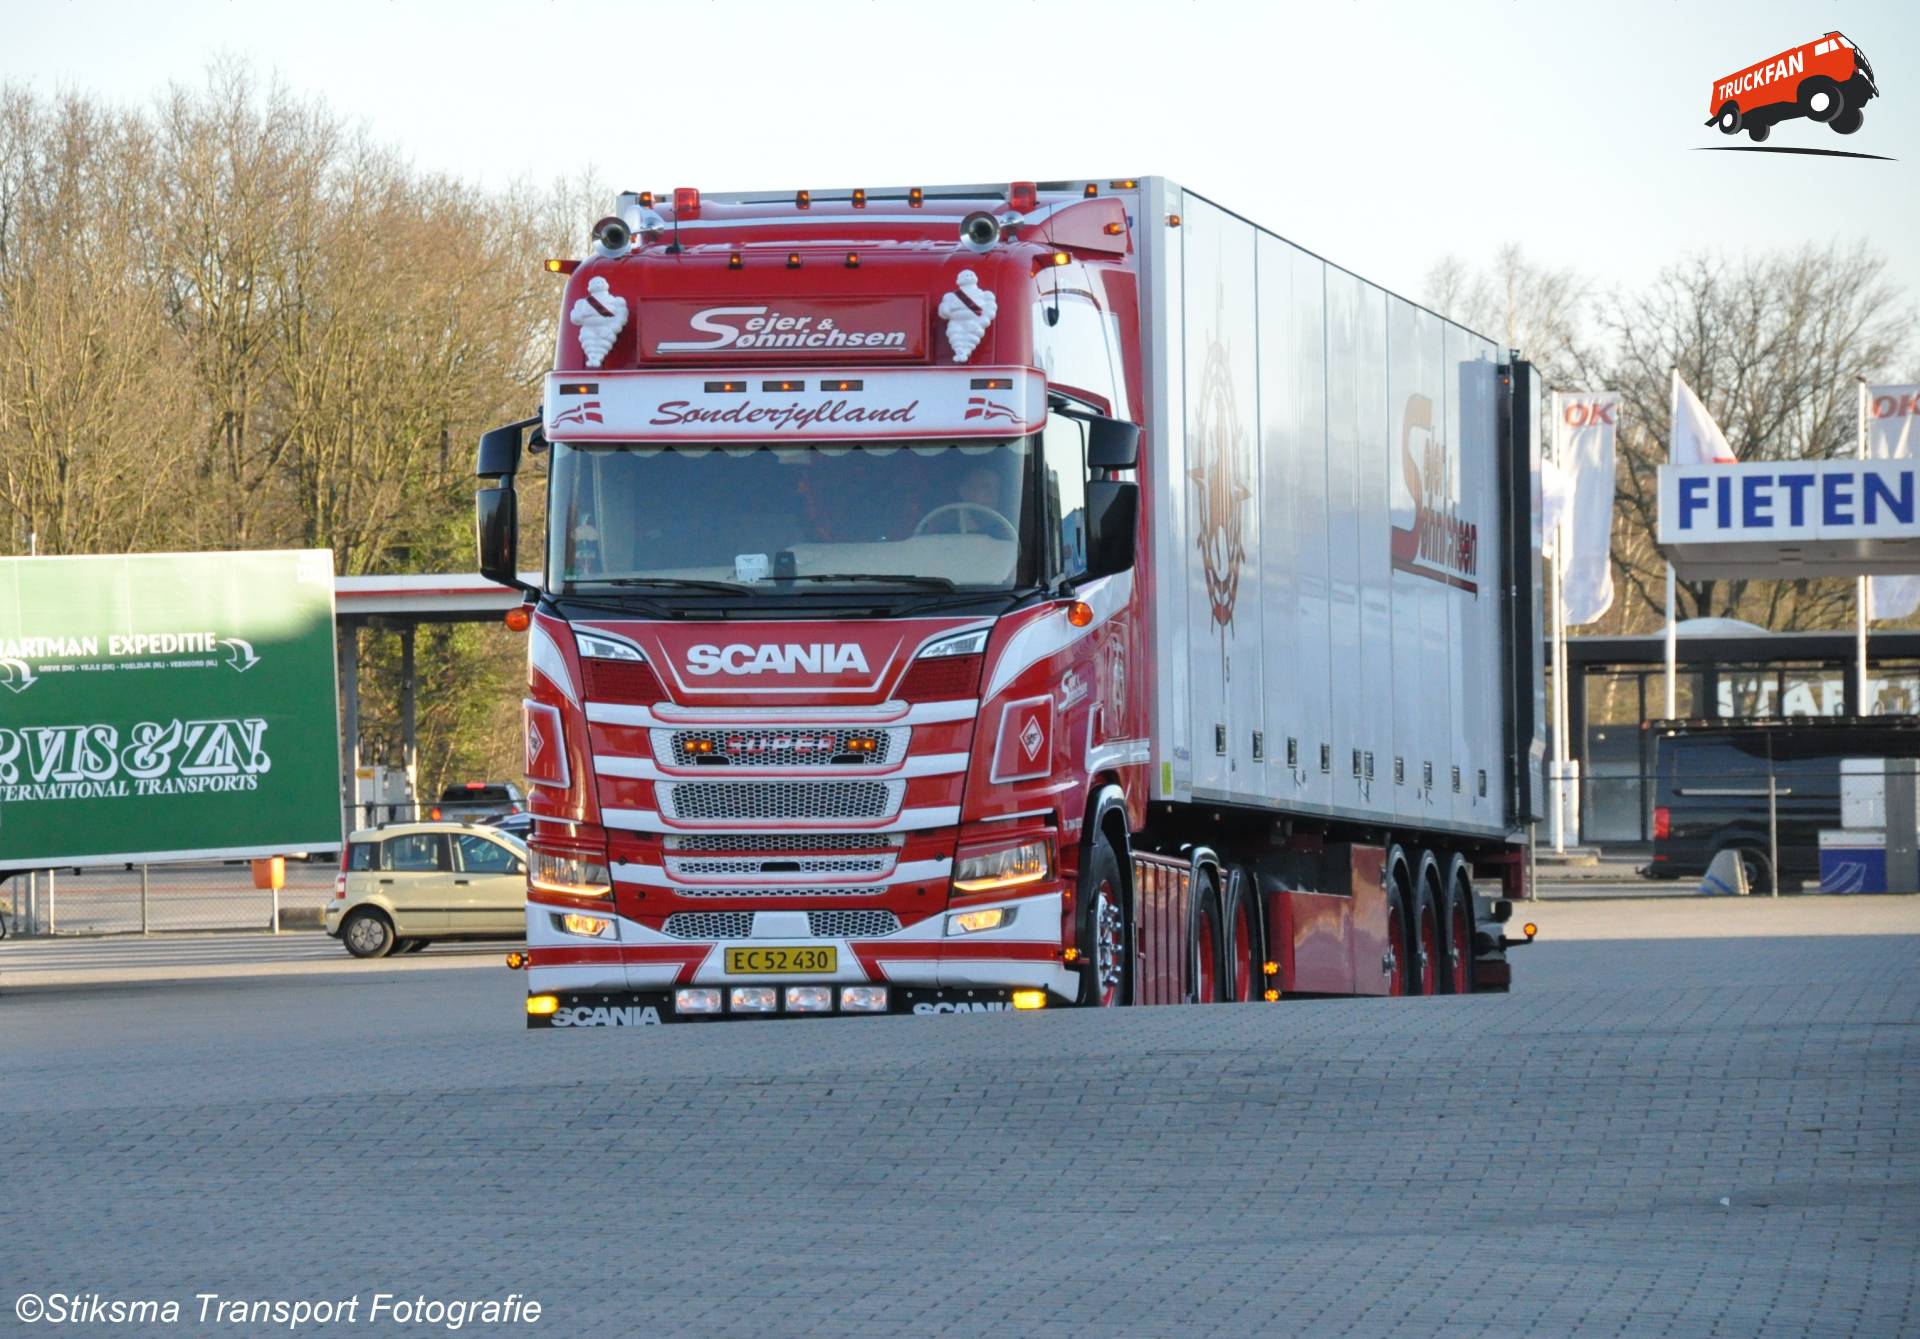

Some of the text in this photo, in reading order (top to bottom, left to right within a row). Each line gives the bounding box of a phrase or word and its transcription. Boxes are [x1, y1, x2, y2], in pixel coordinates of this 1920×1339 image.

[817, 318, 834, 330] &
[1563, 403, 1614, 427] OK
[1678, 471, 1914, 530] FIETEN
[108, 632, 217, 655] EXPEDITIE
[686, 643, 870, 675] SCANIA
[121, 718, 183, 779] &
[725, 735, 836, 754] SUPER
[135, 775, 258, 796] TRANSPORTS
[734, 950, 829, 969] EC 52 430
[551, 1006, 662, 1026] SCANIA
